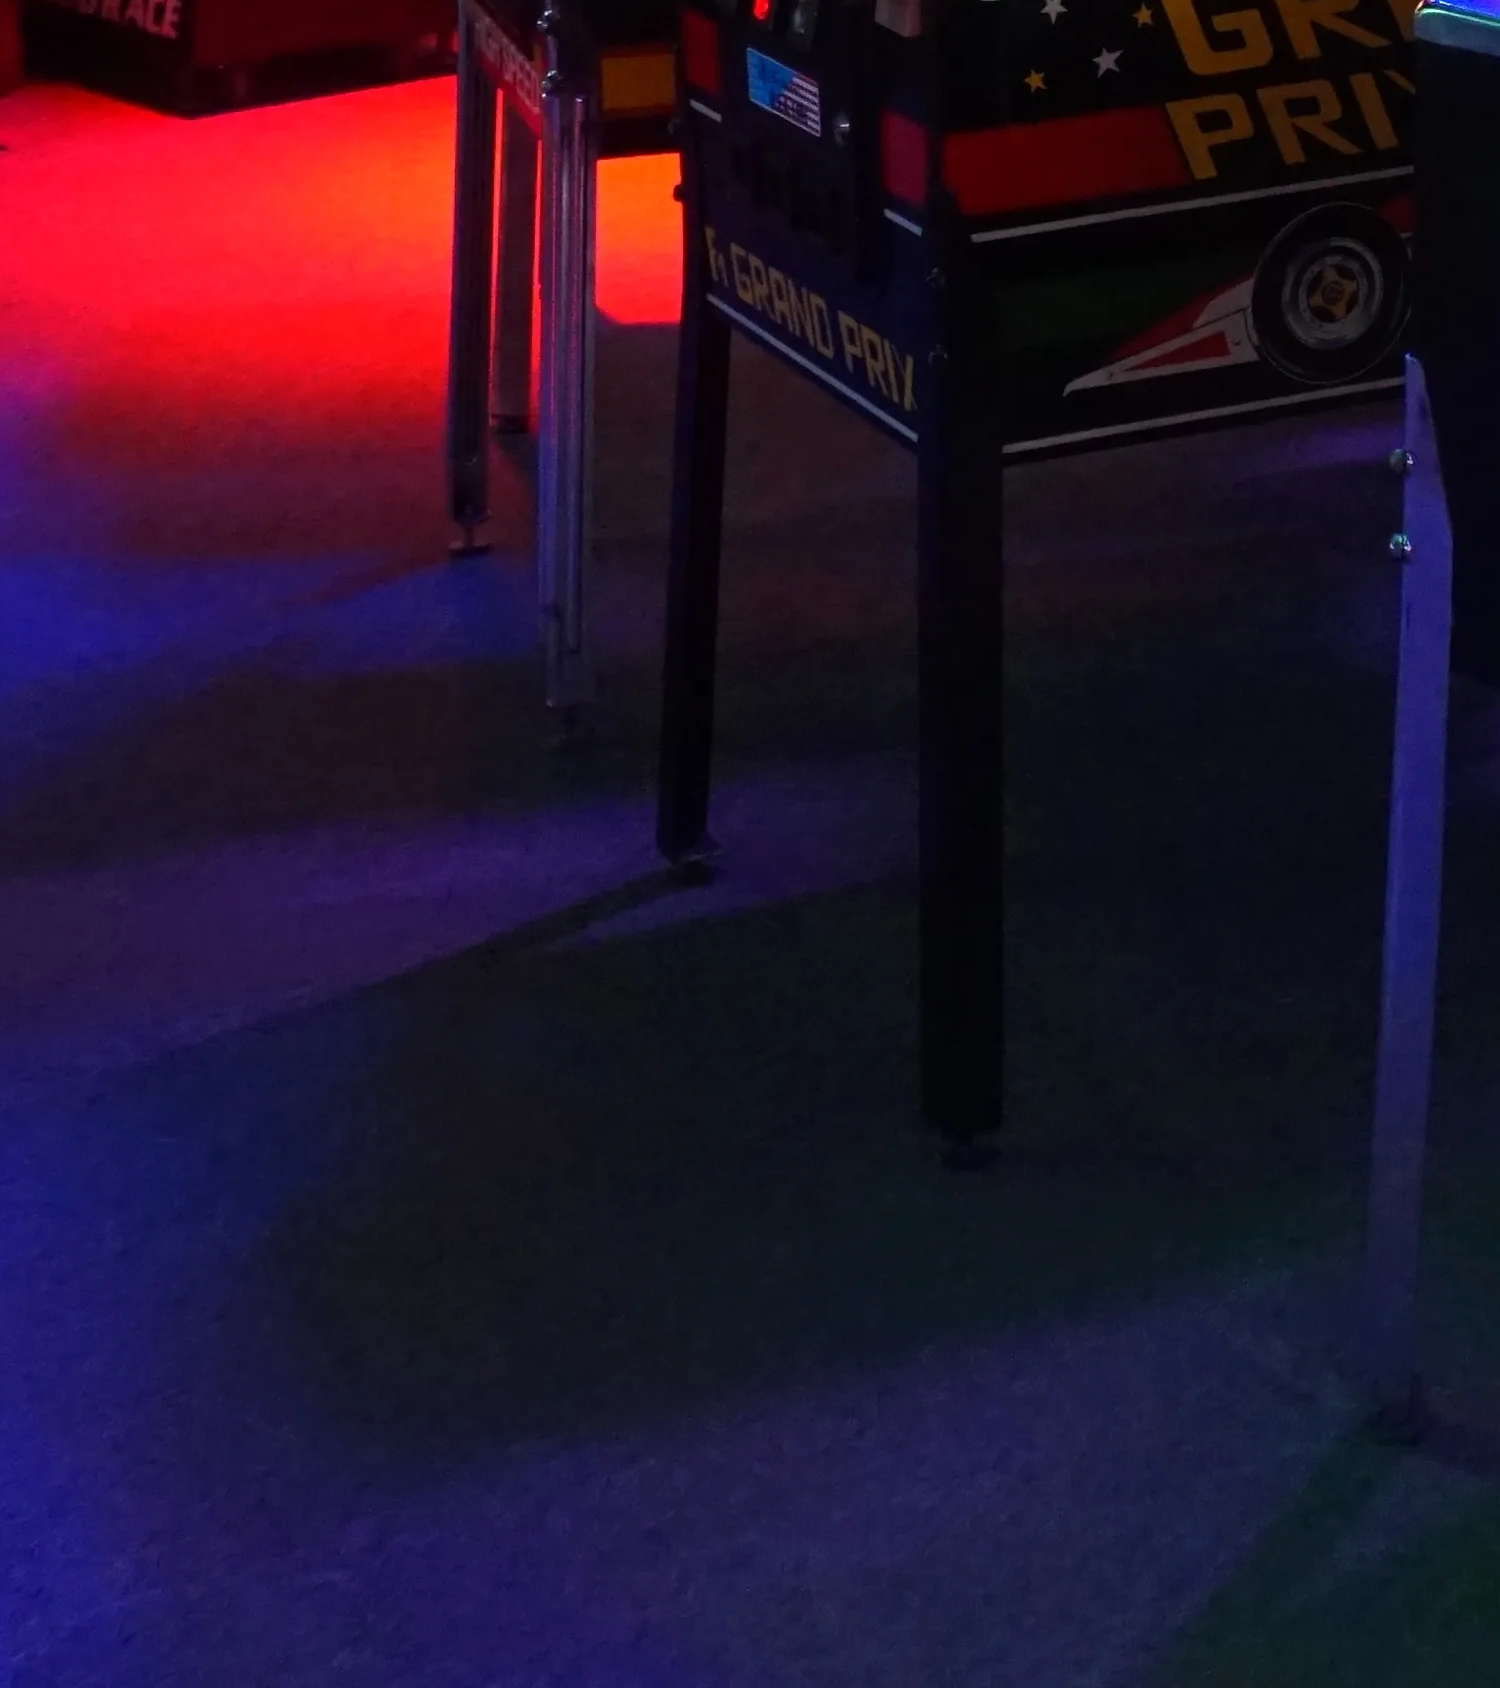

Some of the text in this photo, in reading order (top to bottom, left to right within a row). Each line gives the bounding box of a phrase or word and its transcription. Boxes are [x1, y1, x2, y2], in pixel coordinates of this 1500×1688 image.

[1165, 69, 1416, 181] PRI
[730, 242, 835, 361] GRAND
[837, 309, 919, 413] PRIX
